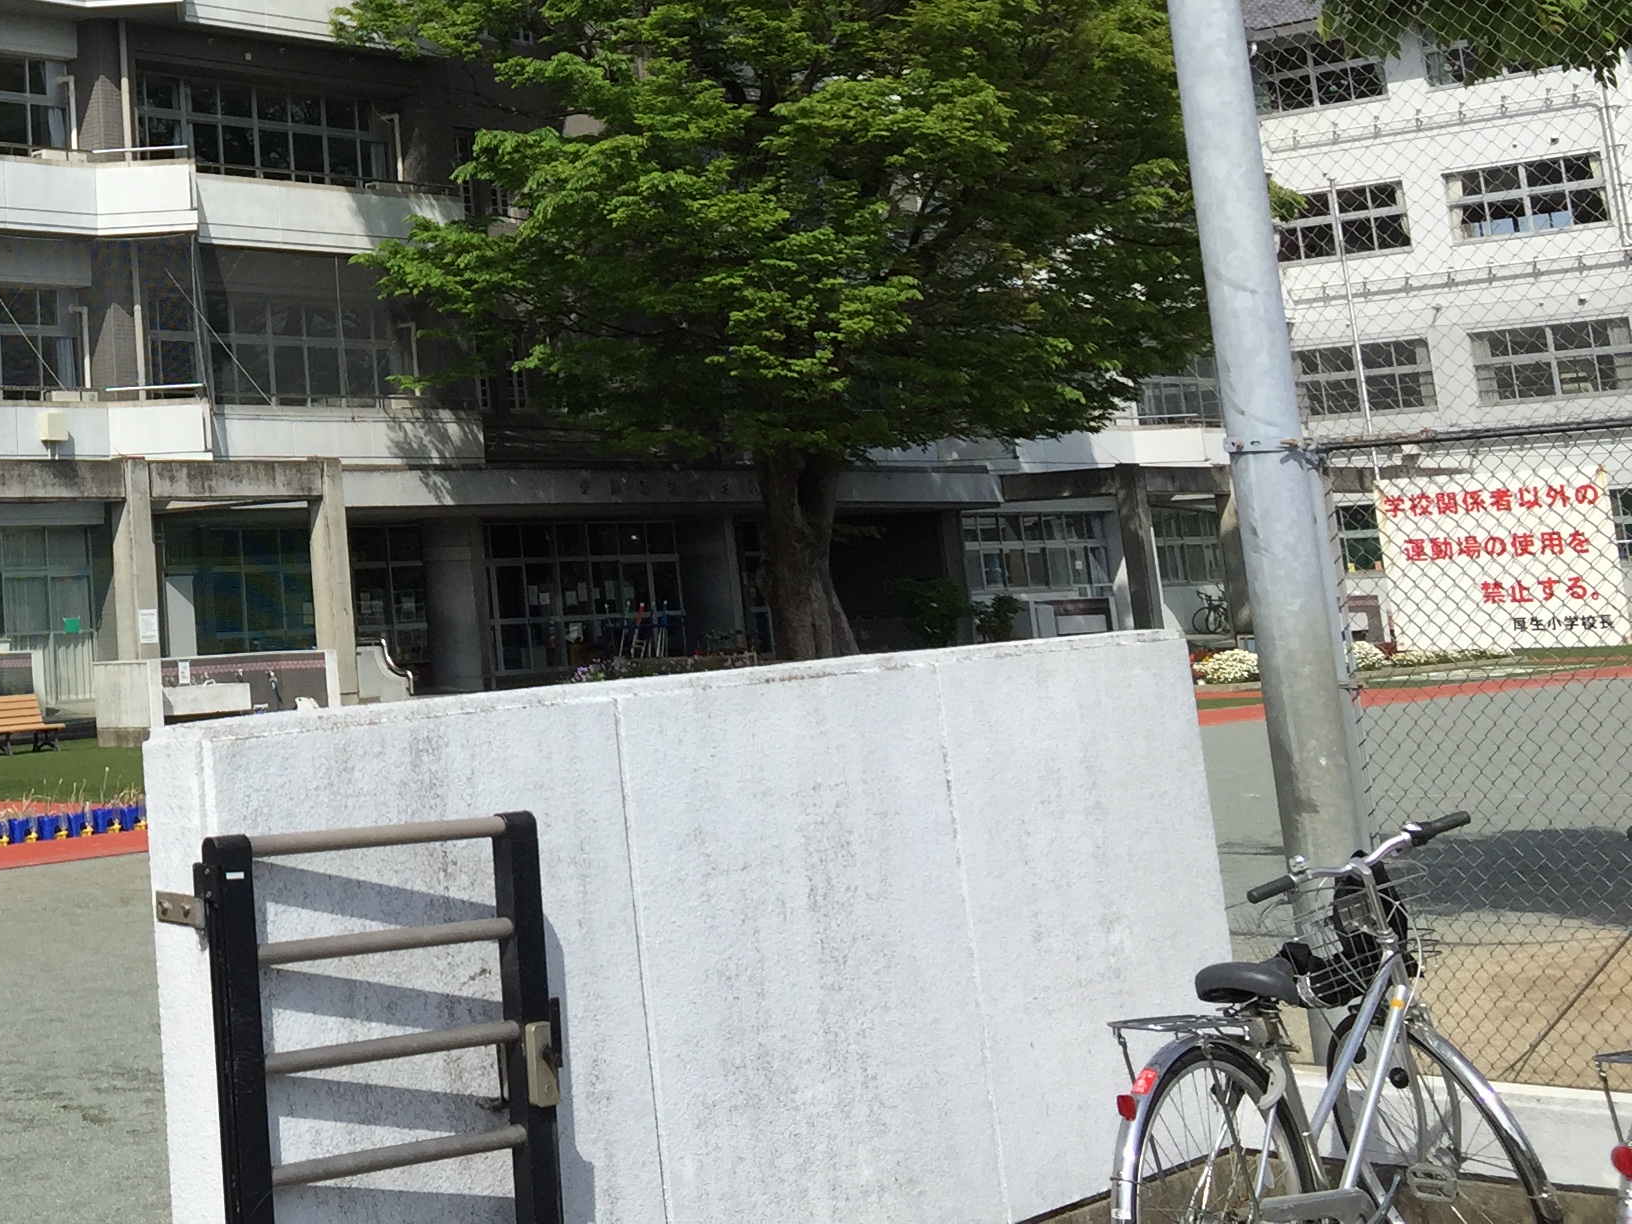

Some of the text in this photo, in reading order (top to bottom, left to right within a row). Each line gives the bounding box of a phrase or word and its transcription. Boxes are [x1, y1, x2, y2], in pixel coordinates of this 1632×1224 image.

[1383, 483, 1599, 518] 学校関係者以外の
[1403, 530, 1590, 562] 運動場の使用を
[1480, 576, 1600, 604] 禁止する。
